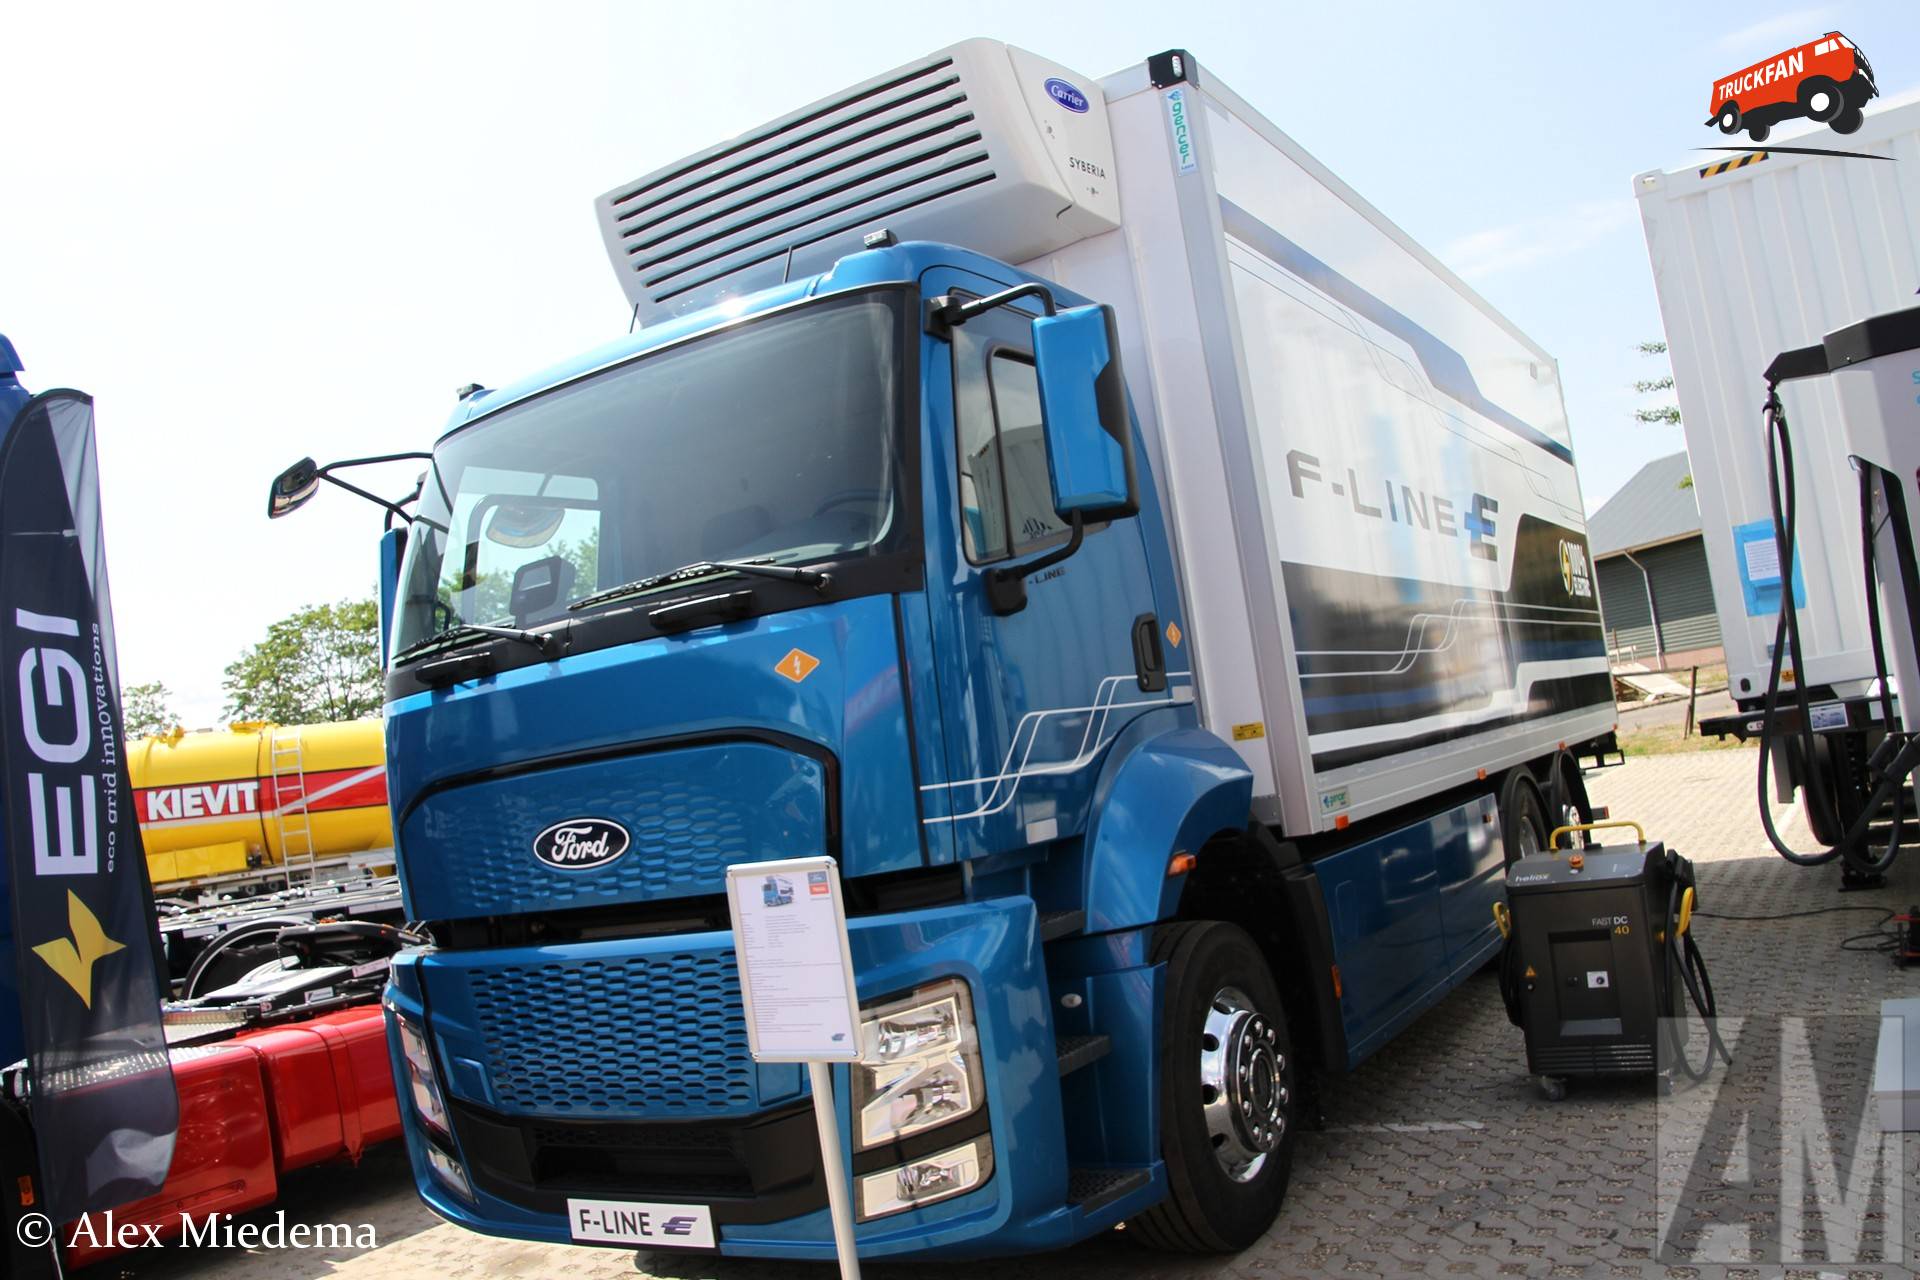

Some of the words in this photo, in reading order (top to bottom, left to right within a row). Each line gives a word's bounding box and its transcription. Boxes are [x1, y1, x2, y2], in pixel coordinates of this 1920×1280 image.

[1051, 84, 1083, 107] Carrier
[1173, 102, 1189, 164] gencer
[1069, 157, 1106, 179] SYBERIA
[1286, 449, 1458, 537] F-LINE
[1028, 566, 1066, 585] -LINE
[92, 623, 117, 767] innovations
[16, 608, 98, 876] EGI
[102, 772, 118, 824] grid
[146, 781, 258, 820] KIEVIT
[107, 830, 117, 874] eco
[551, 826, 610, 862] Ford
[1515, 873, 1550, 882] heliox
[1592, 917, 1612, 926] FAST
[1613, 916, 1629, 925] DC
[1614, 926, 1630, 935] 40
[579, 1209, 653, 1236] F-LINE
